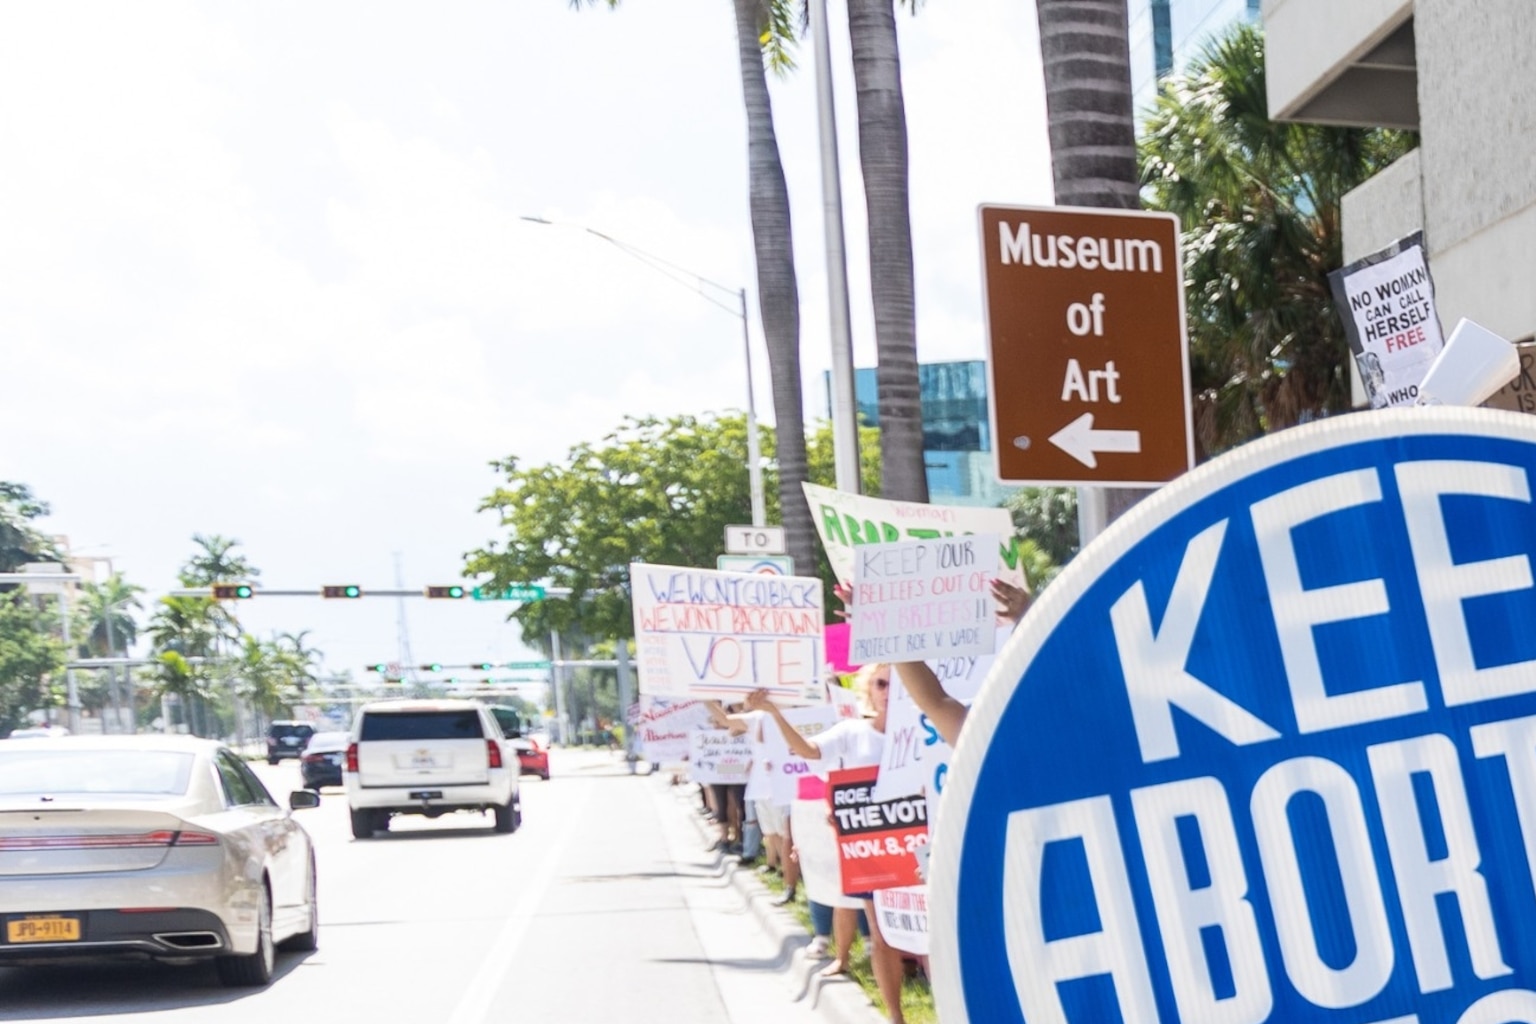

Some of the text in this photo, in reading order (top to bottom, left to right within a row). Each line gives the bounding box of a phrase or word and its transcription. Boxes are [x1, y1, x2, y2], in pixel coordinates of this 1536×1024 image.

[999, 221, 1162, 273] Museum
[1351, 266, 1426, 311] NO WOMXN
[1066, 293, 1105, 336] of
[1366, 289, 1424, 321] CAN CALL
[1365, 302, 1430, 342] HERSELF
[1385, 326, 1426, 353] FREE
[1061, 359, 1121, 403] Art
[1388, 385, 1418, 404] WHO
[1517, 393, 1535, 412] IS
[742, 532, 767, 548] TO
[863, 541, 975, 578] KEEP YOUR
[647, 573, 684, 604] WE
[766, 582, 820, 609] BACK
[859, 571, 991, 606] BELIEFS OUT OF
[639, 605, 672, 632] WE
[731, 606, 771, 636] BACK
[773, 610, 821, 636] DOWN
[858, 609, 887, 634] MY
[855, 630, 900, 660] PROTECT
[906, 633, 926, 652] ROE
[950, 628, 981, 647] WADE
[834, 804, 884, 830] THE
[841, 839, 886, 860] NOV.
